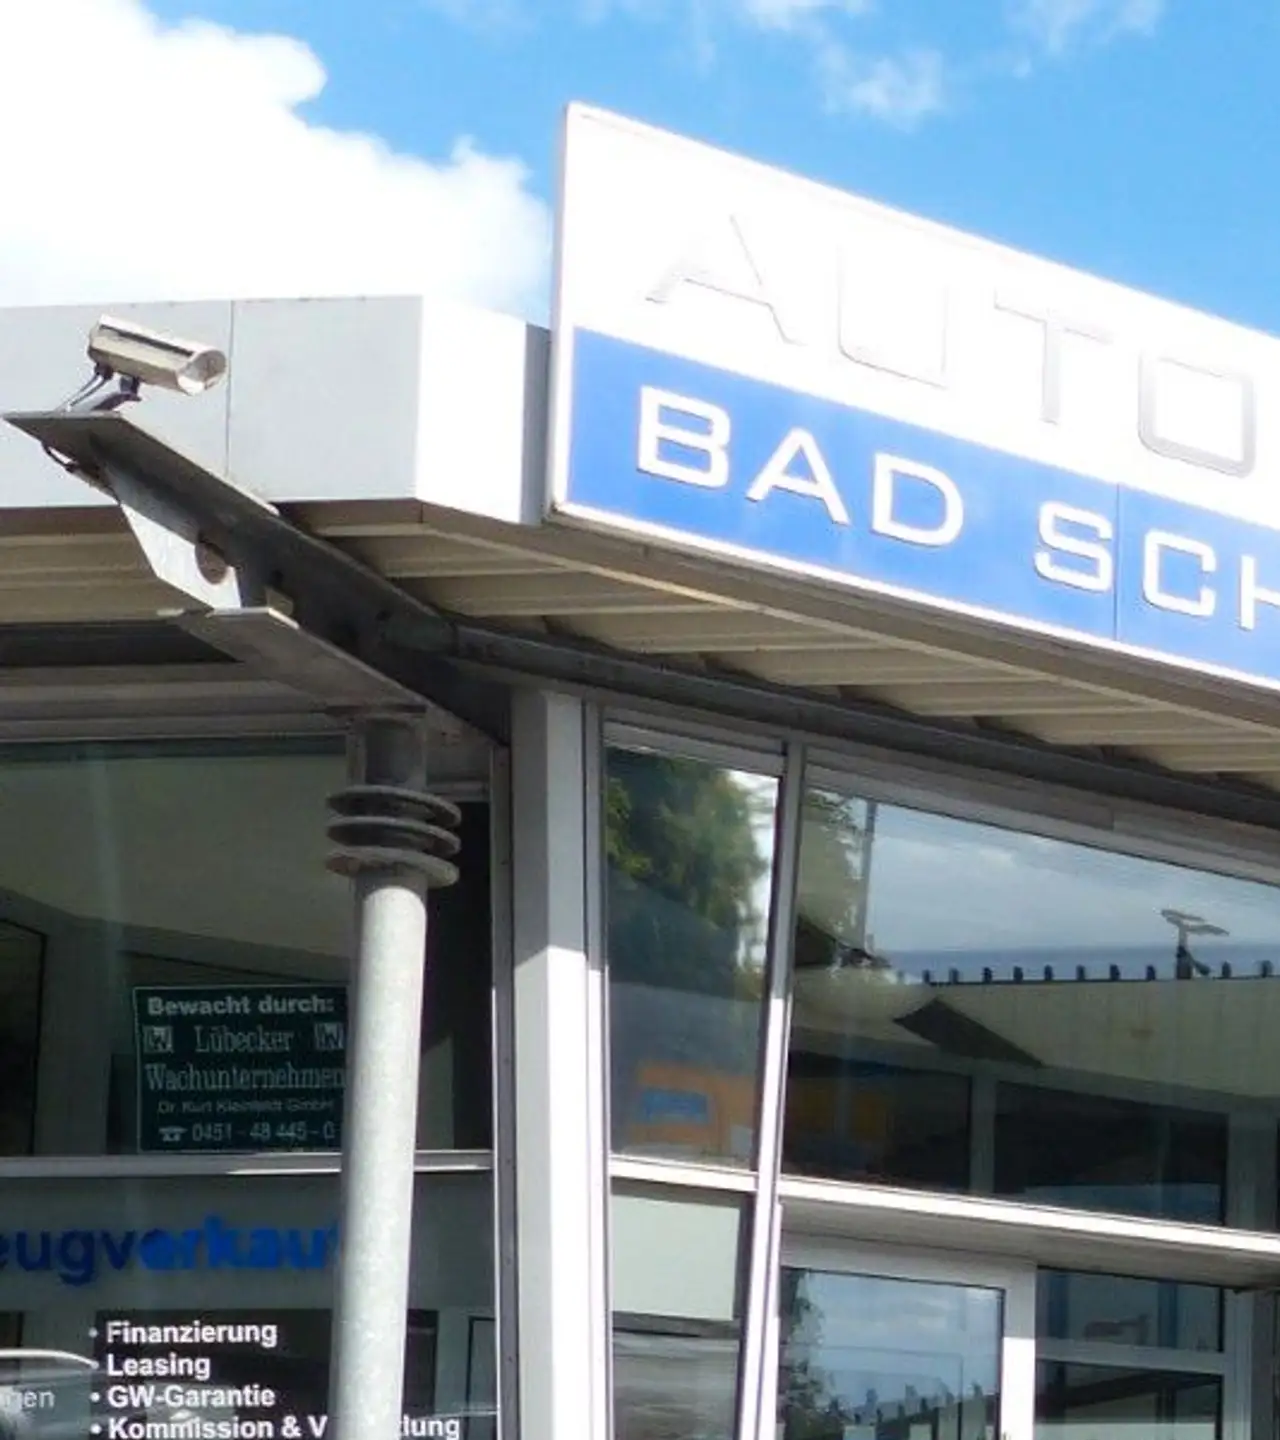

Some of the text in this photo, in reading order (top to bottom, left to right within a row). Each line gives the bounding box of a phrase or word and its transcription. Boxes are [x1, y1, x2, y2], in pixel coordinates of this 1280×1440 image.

[636, 385, 966, 548] BAD
[147, 994, 335, 1015] Bewacht durch:
[194, 1024, 295, 1052] Lübecker
[145, 1061, 347, 1091] Wachunternehmen
[192, 1121, 232, 1141] 0451
[0, 1214, 340, 1286] ugverkau
[106, 1320, 278, 1347] Finanzierung
[107, 1353, 211, 1380] Leasing
[107, 1384, 276, 1408] GW-Garantie
[108, 1416, 276, 1440] Kommission
[281, 1417, 302, 1439] &
